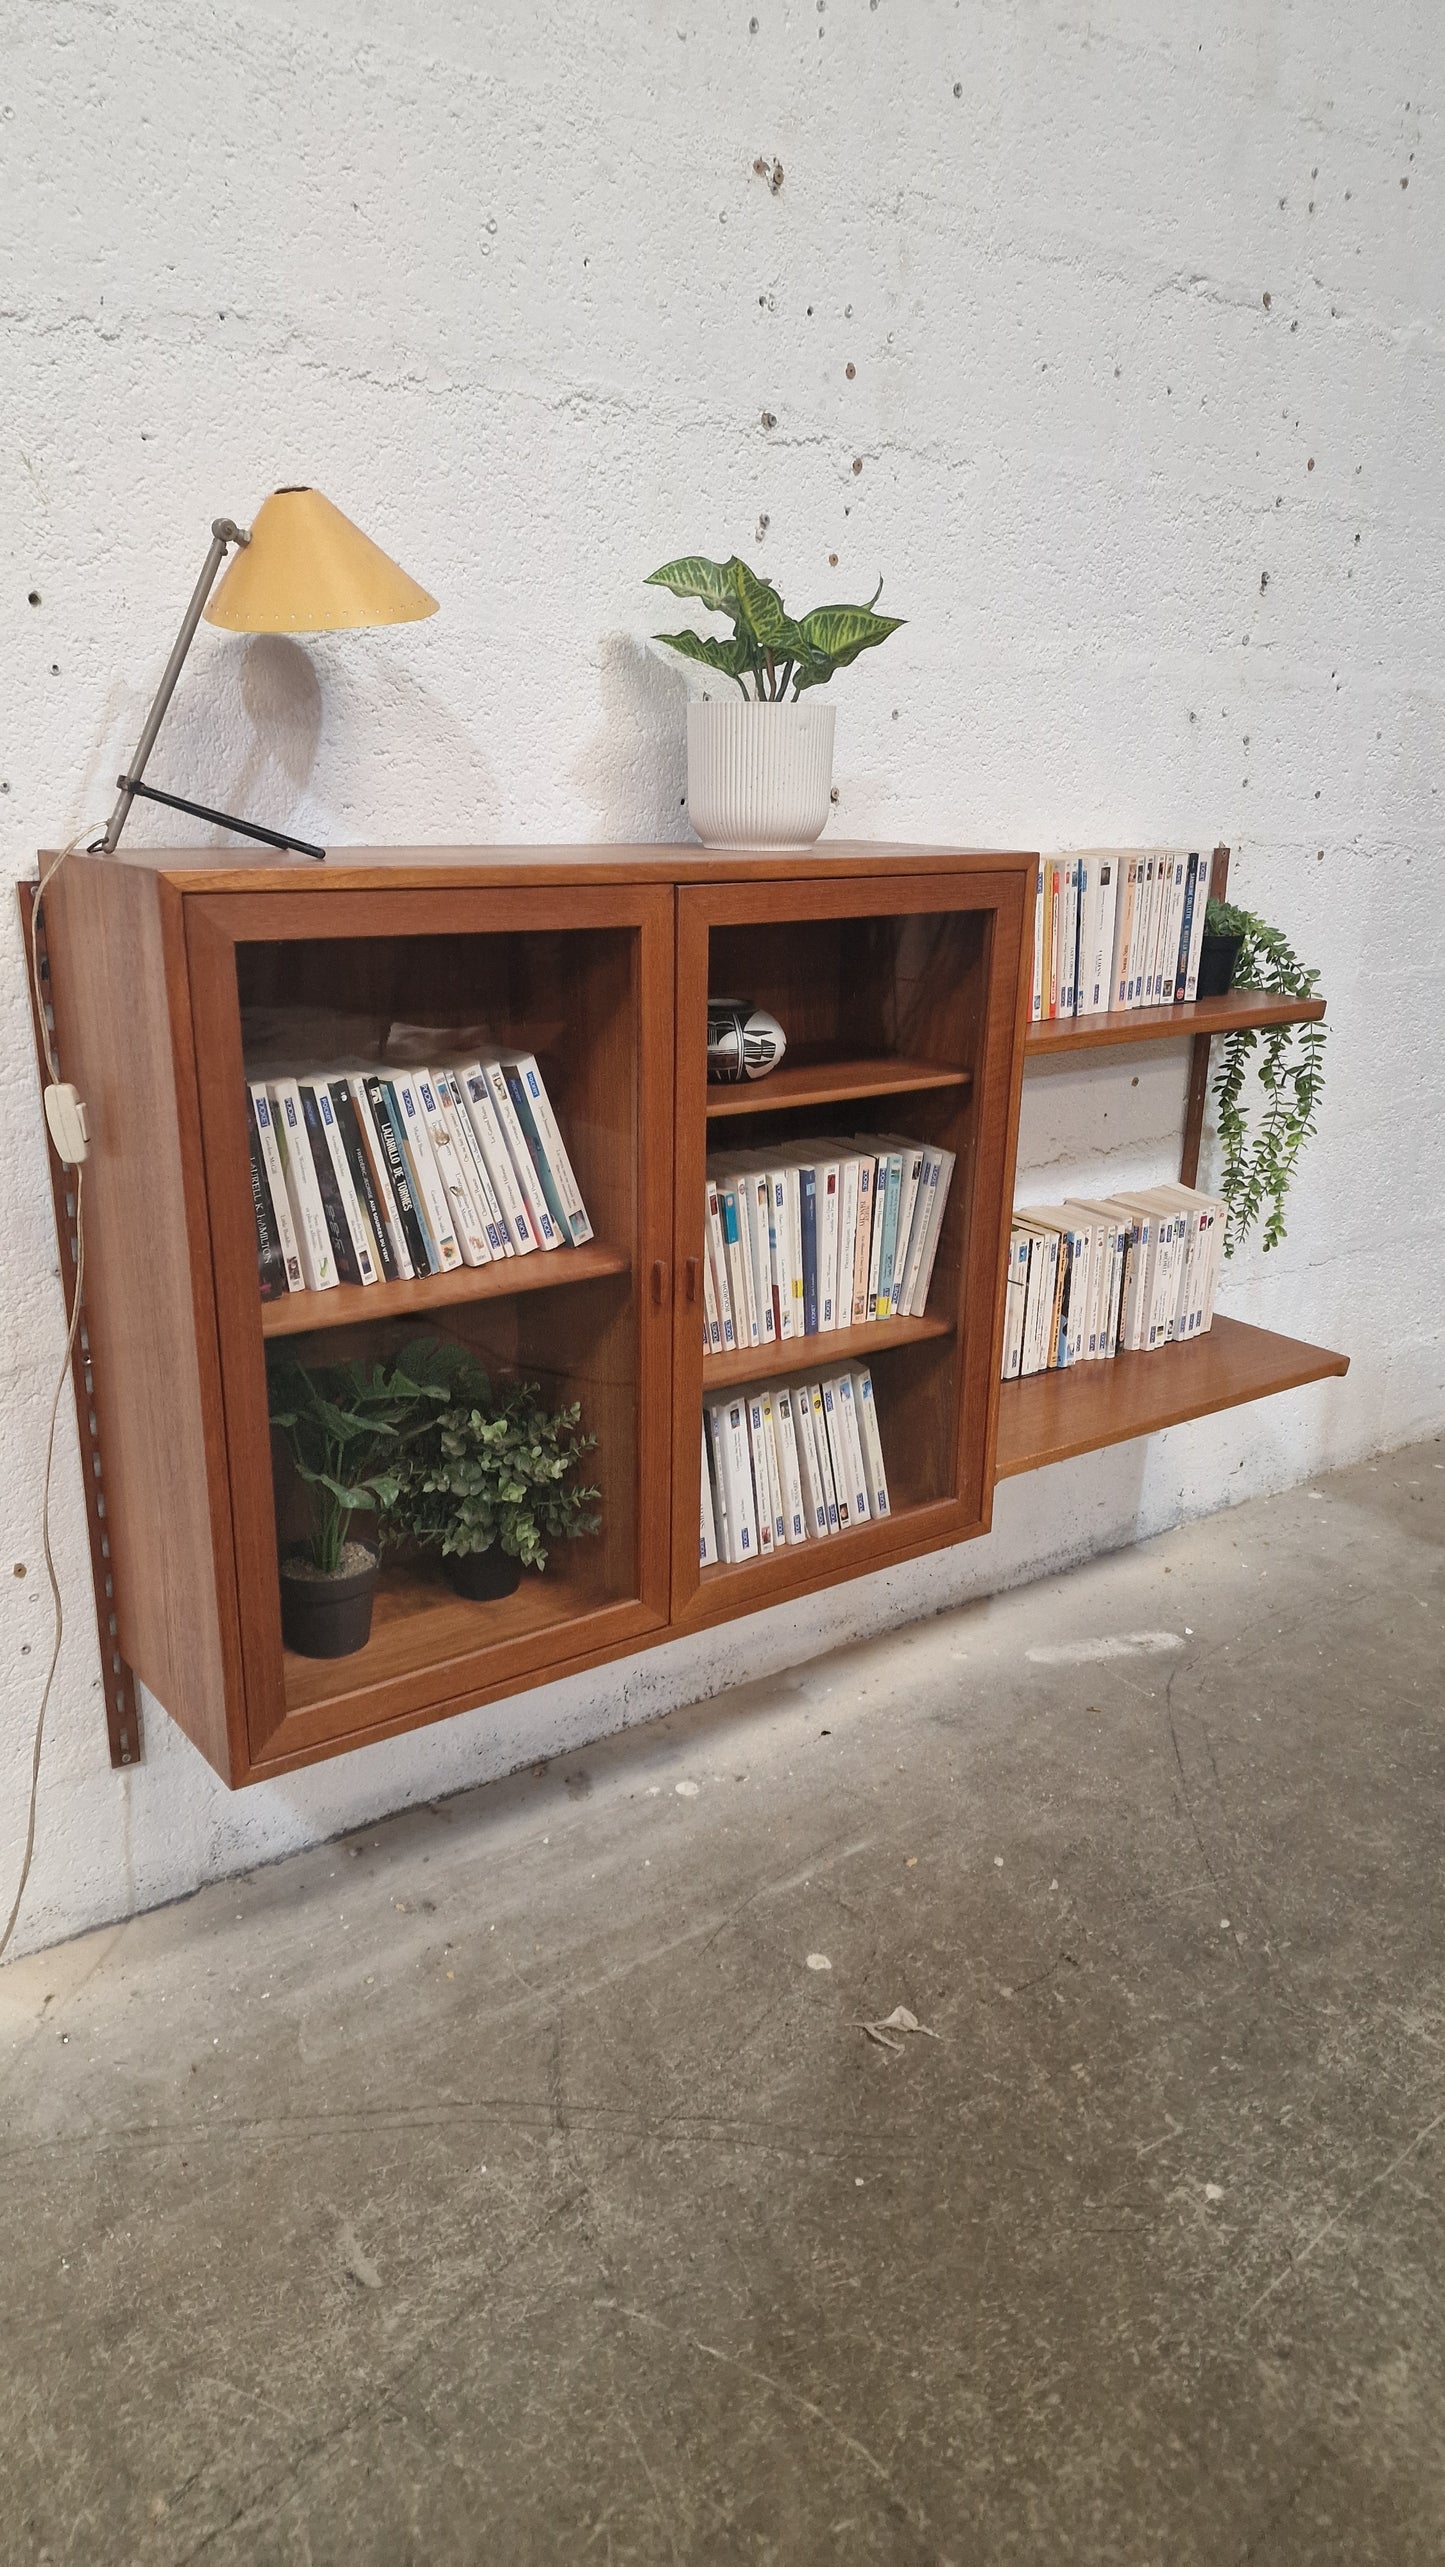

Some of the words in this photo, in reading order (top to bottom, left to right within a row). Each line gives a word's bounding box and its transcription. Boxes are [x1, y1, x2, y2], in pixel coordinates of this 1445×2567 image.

[508, 1078, 521, 1103] POCKET
[525, 1071, 540, 1098] POCKET
[401, 1088, 415, 1117] POCKET
[419, 1083, 436, 1112] POCKET
[255, 1097, 270, 1127] POCKET
[284, 1097, 297, 1127] POCKET
[319, 1096, 333, 1125] POCKET
[380, 1122, 400, 1164] LAZARILLO
[355, 1148, 367, 1175] FRÉDÉRIC
[392, 1166, 404, 1178] DE
[861, 1169, 869, 1192] POCKET
[878, 1167, 886, 1190] POCKET
[368, 1199, 376, 1211] AUX
[395, 1179, 413, 1212] TORMES
[775, 1183, 783, 1207] POCKET
[372, 1212, 383, 1238] SOURCES
[485, 1223, 500, 1249] POCKET
[496, 1219, 510, 1244] POCKET
[514, 1214, 529, 1240] POCKET
[539, 1213, 553, 1238] POCKET
[256, 1214, 271, 1263] HAMILTON
[378, 1238, 385, 1247] DU
[381, 1247, 389, 1262] VENT
[891, 1282, 900, 1304] POCKET
[710, 1321, 719, 1343] POCKET
[723, 1319, 733, 1341] POCKET
[824, 1390, 833, 1412] POCKET
[751, 1406, 760, 1429] POCKET
[877, 1489, 886, 1510] POCKET
[775, 1516, 784, 1536] POCKET
[792, 1514, 801, 1535] POCKET
[741, 1527, 749, 1549] POCKET
